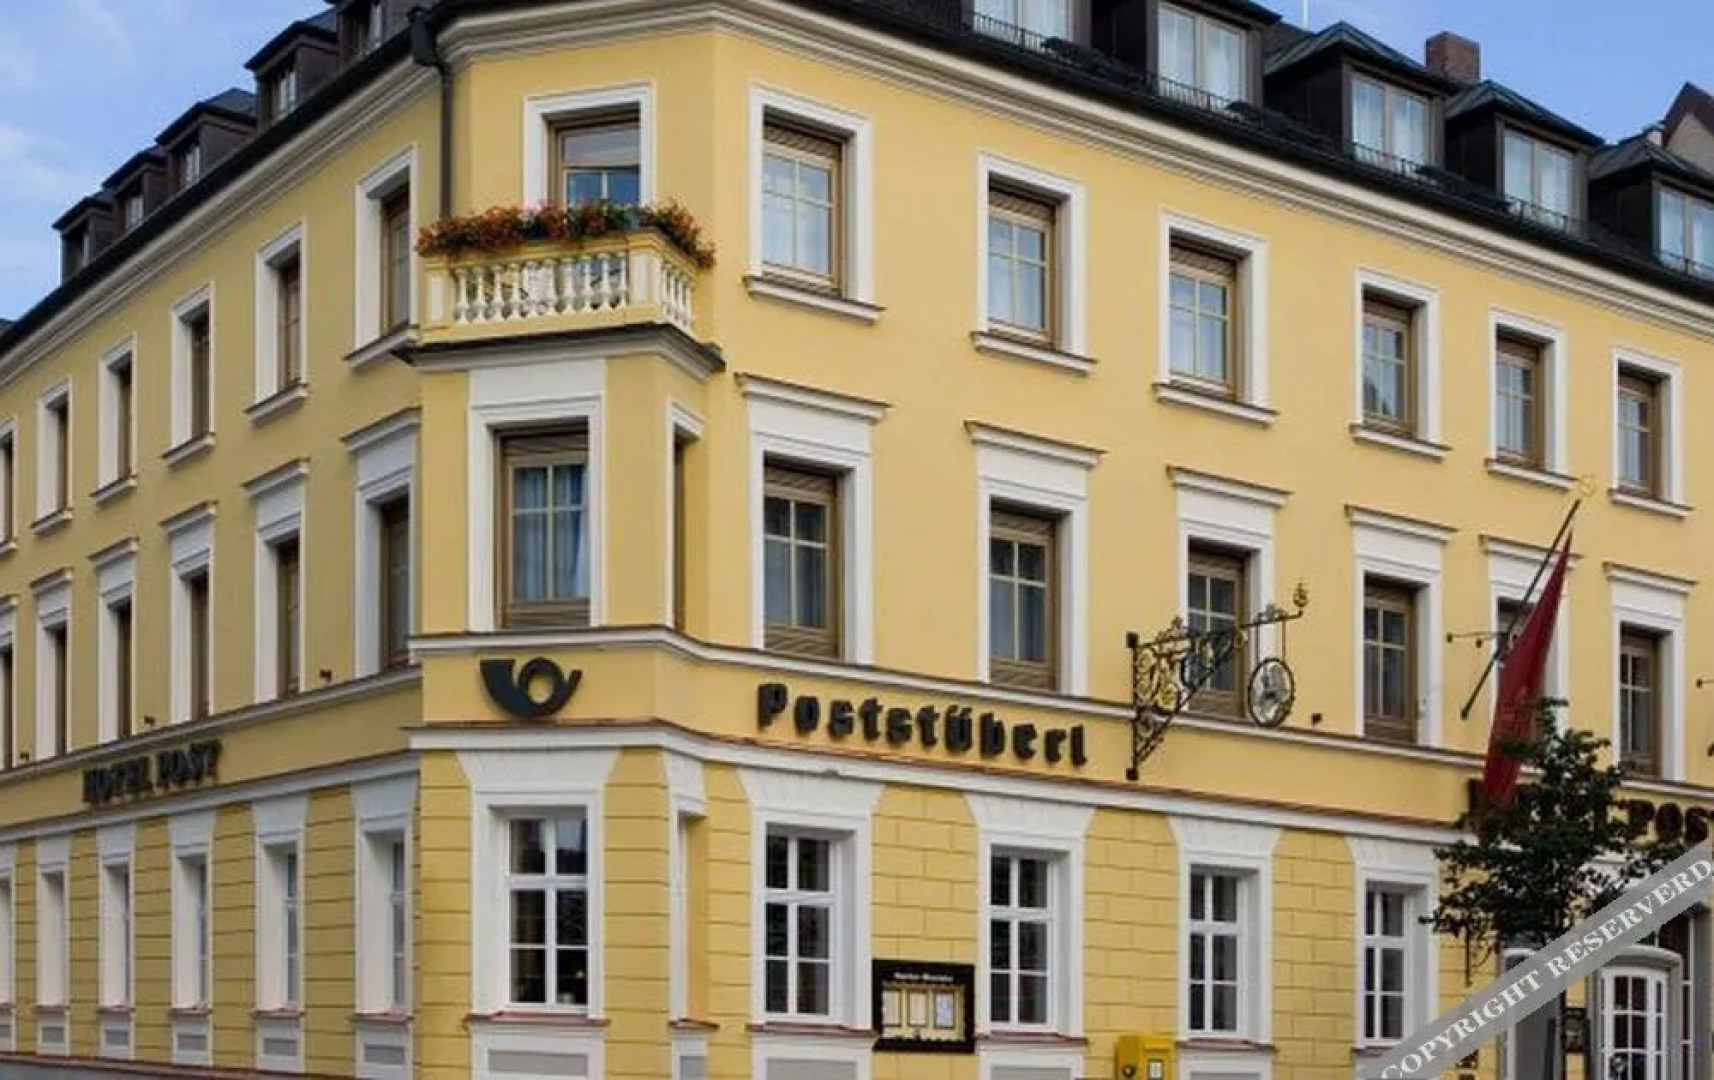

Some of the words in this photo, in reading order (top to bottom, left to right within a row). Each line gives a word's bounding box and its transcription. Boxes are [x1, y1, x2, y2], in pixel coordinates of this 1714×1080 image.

[756, 681, 1089, 767] Poststüberl
[82, 754, 153, 806] HOTEL
[155, 738, 221, 790] POST
